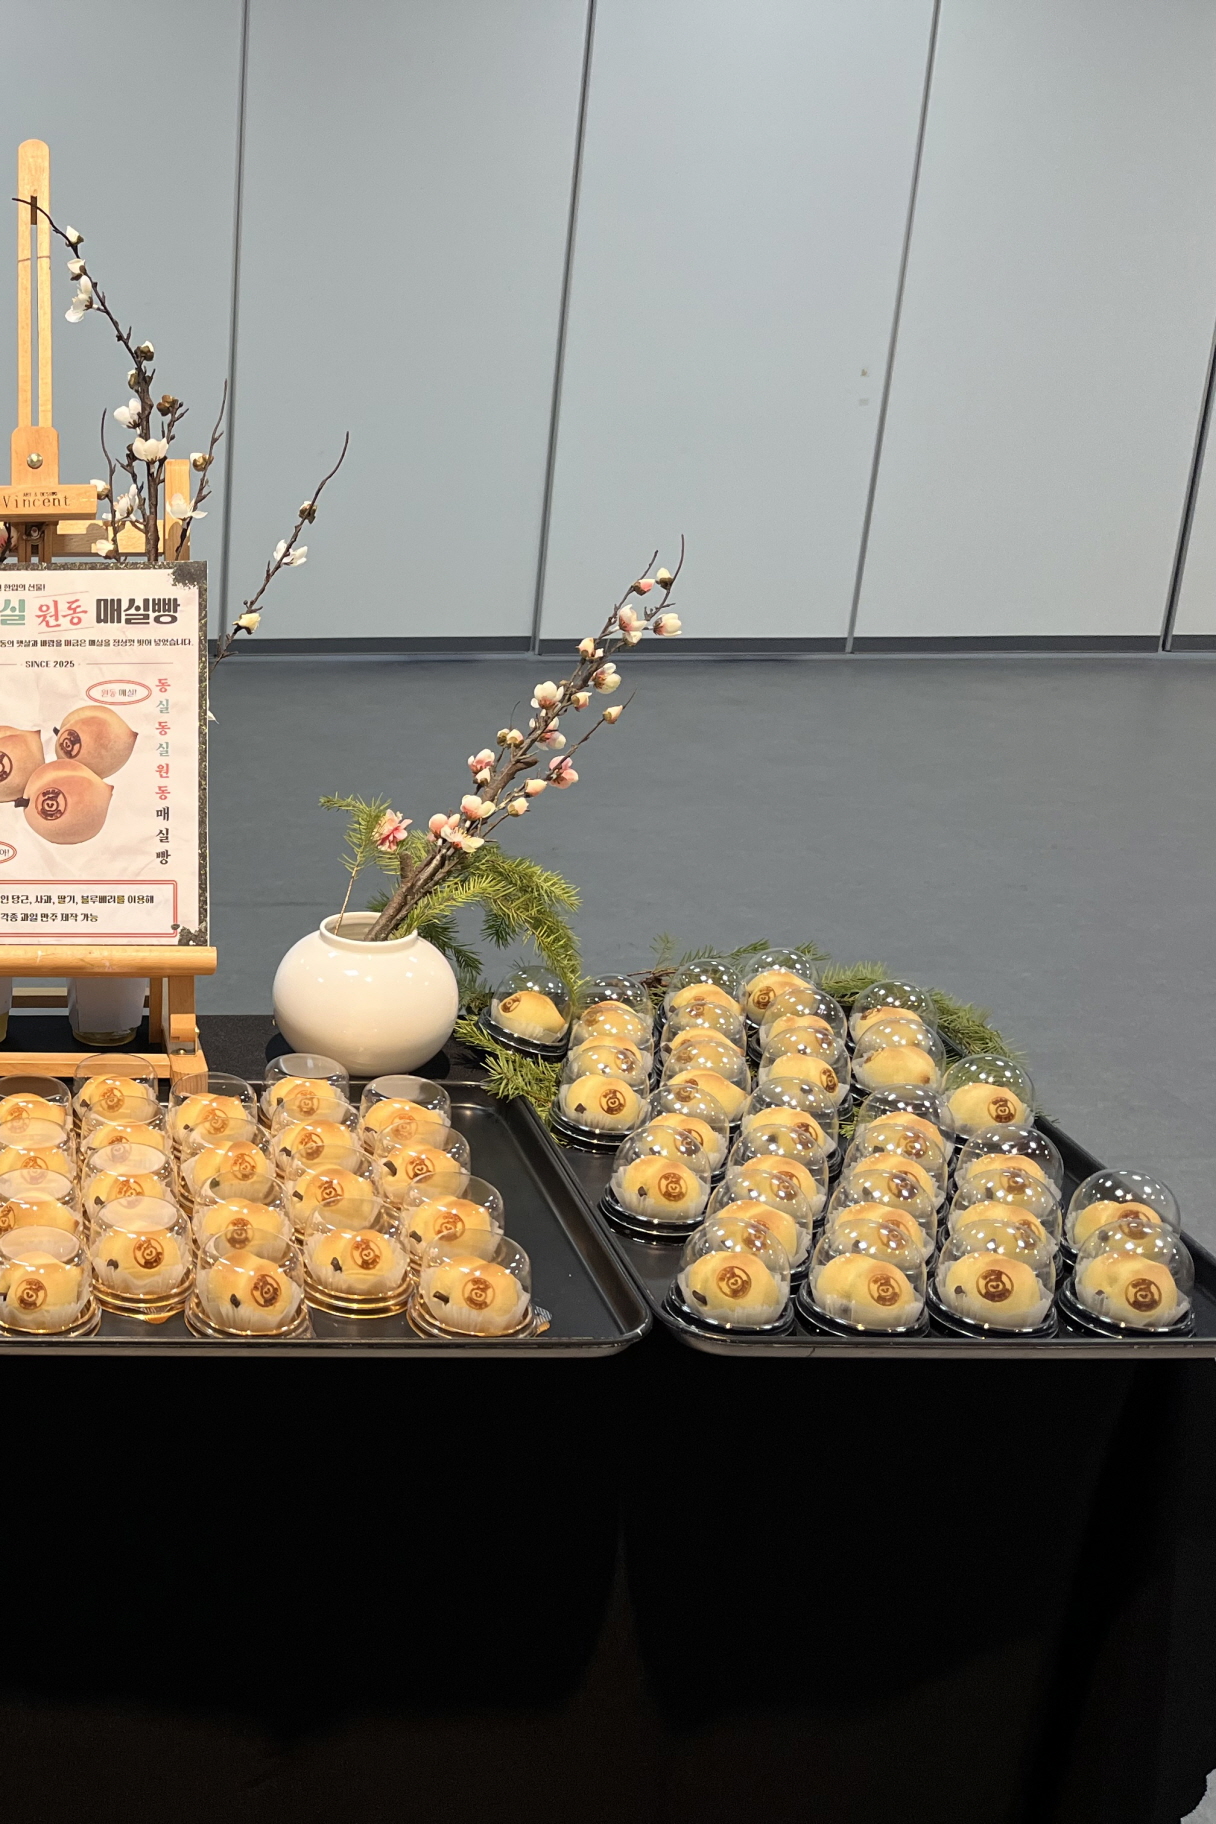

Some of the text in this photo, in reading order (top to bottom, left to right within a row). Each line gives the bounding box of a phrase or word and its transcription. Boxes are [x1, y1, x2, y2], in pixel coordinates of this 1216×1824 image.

[2, 495, 70, 508] Vincent
[36, 599, 88, 628] 원동
[96, 597, 181, 625] 매실빵
[25, 659, 75, 669] SINCE 2025
[101, 688, 116, 698] 원동
[11, 894, 32, 906] 당근,
[34, 894, 55, 906] 사과,
[57, 894, 78, 906] 딸기,
[127, 894, 154, 905] 이용해
